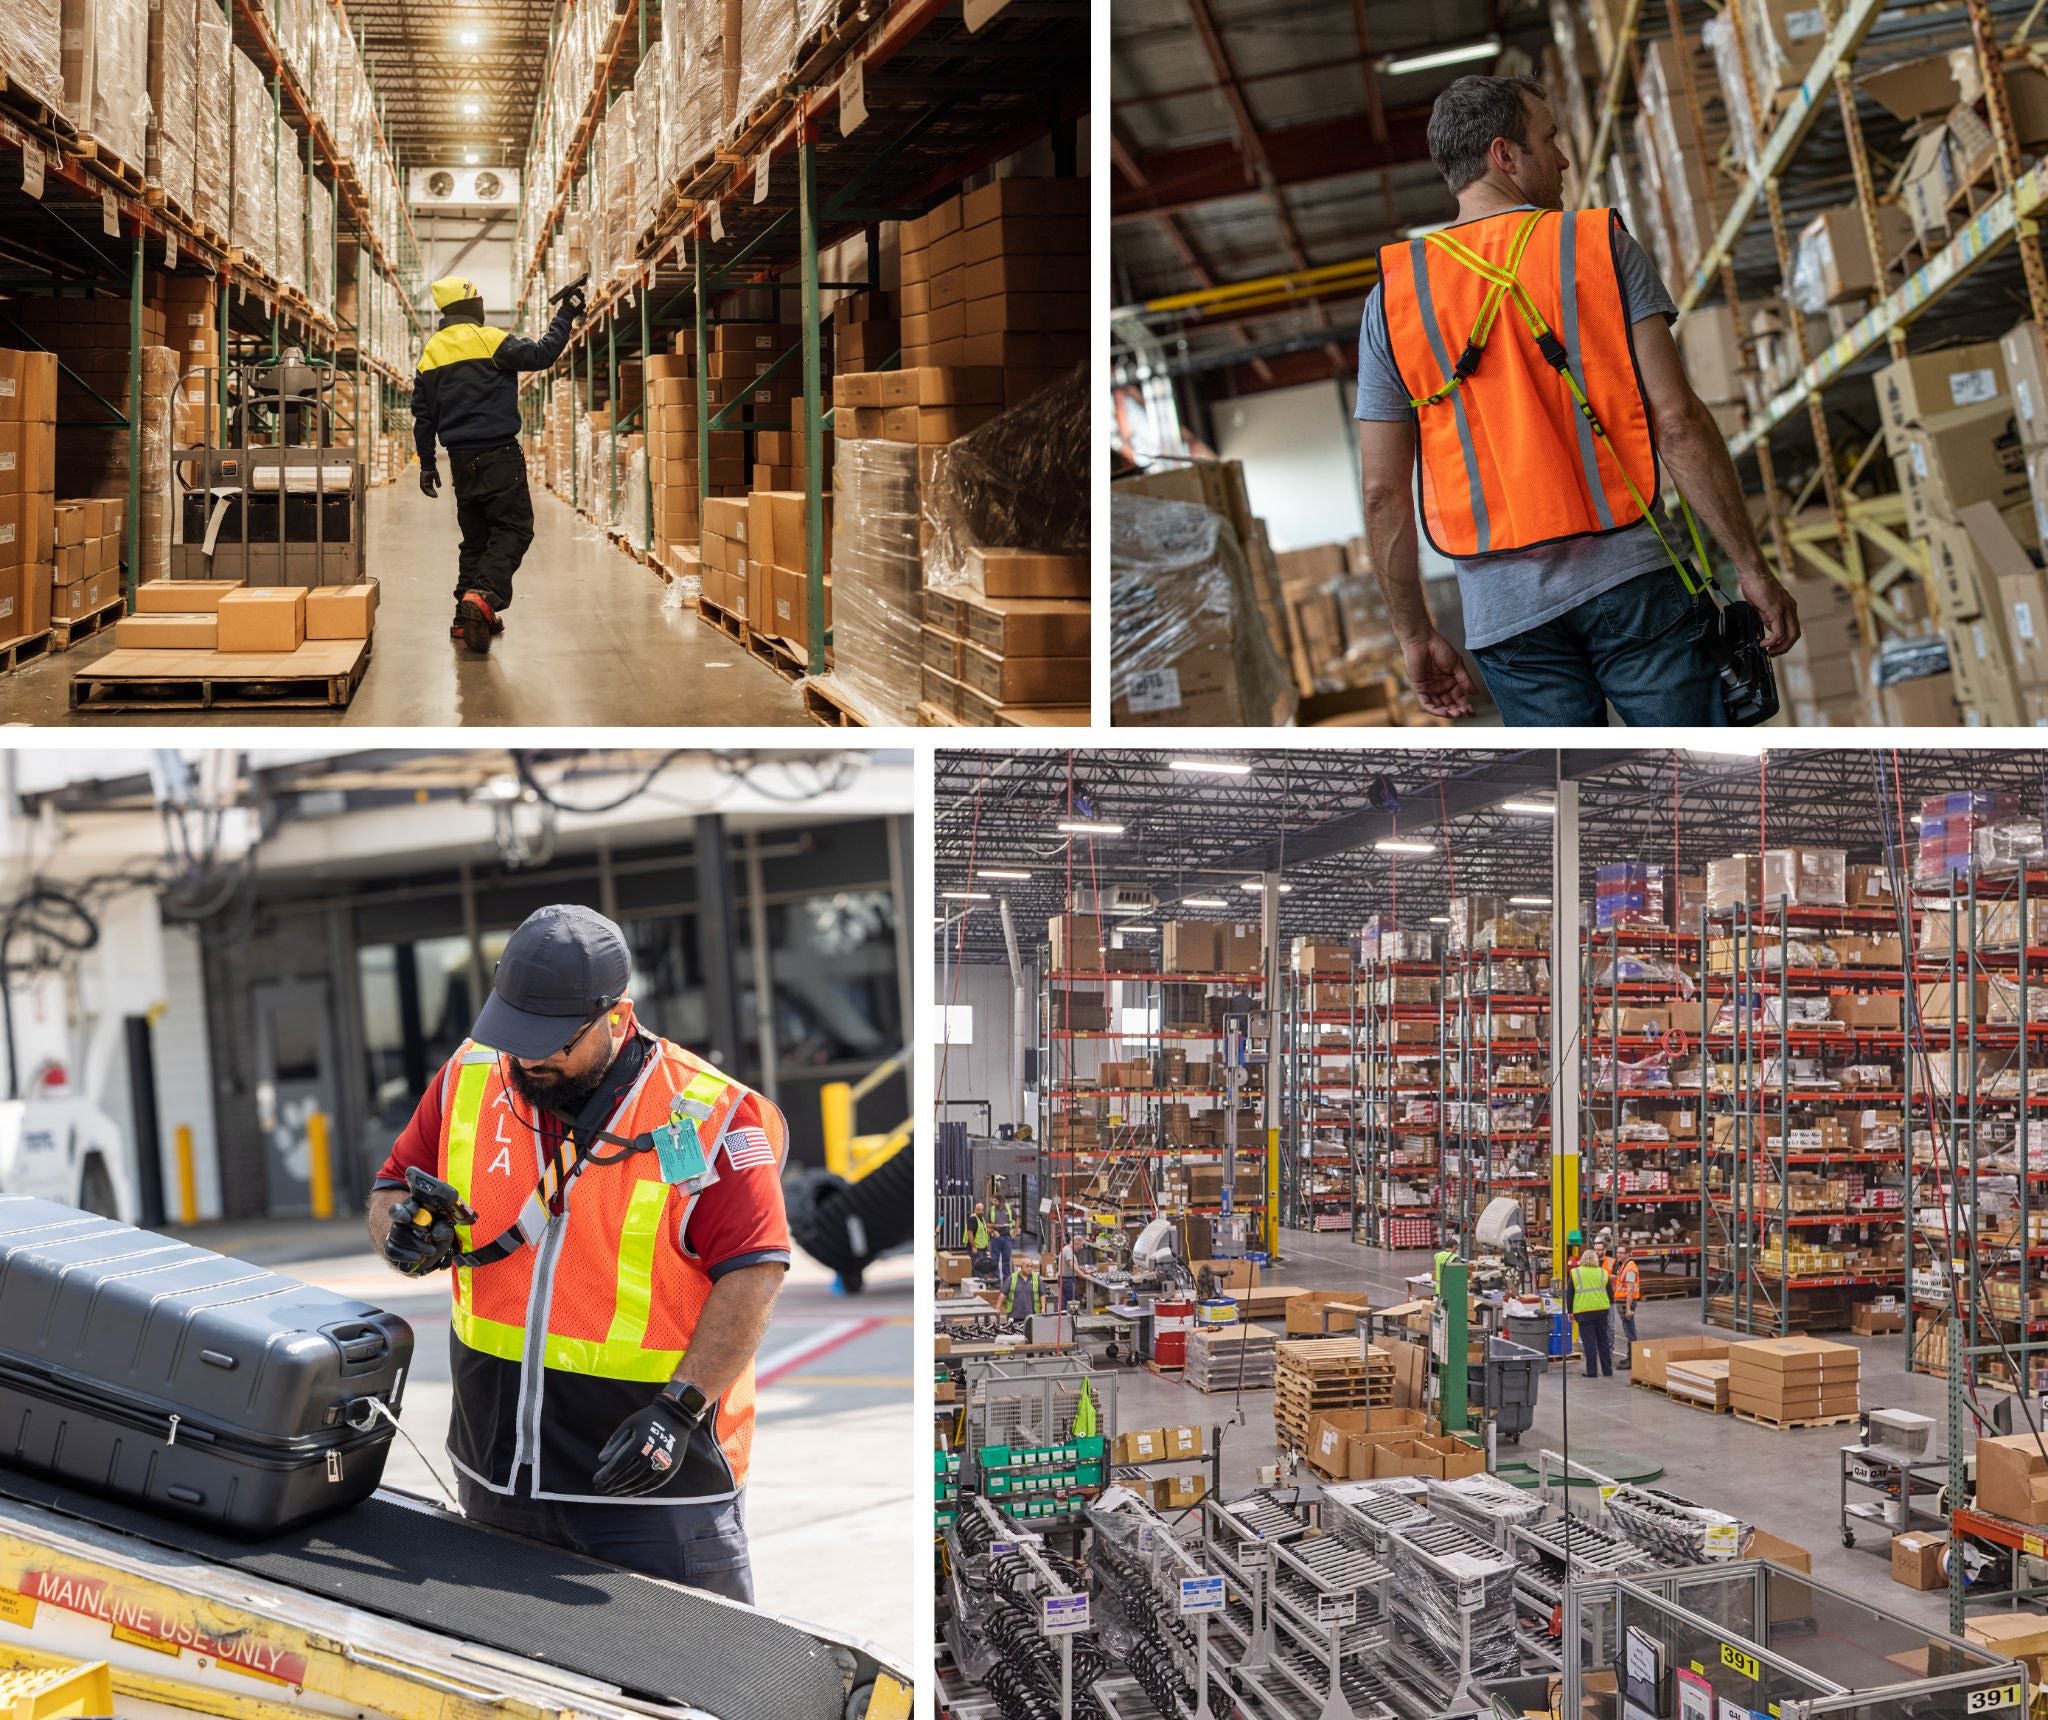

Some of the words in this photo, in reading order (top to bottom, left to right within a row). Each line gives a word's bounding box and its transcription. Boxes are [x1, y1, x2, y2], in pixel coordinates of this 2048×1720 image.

[38, 1572, 152, 1631] MAINLINE
[160, 1614, 209, 1650] USE
[217, 1633, 284, 1672] ONLY
[1724, 1647, 1754, 1674] 391
[1972, 1687, 2014, 1709] 391
